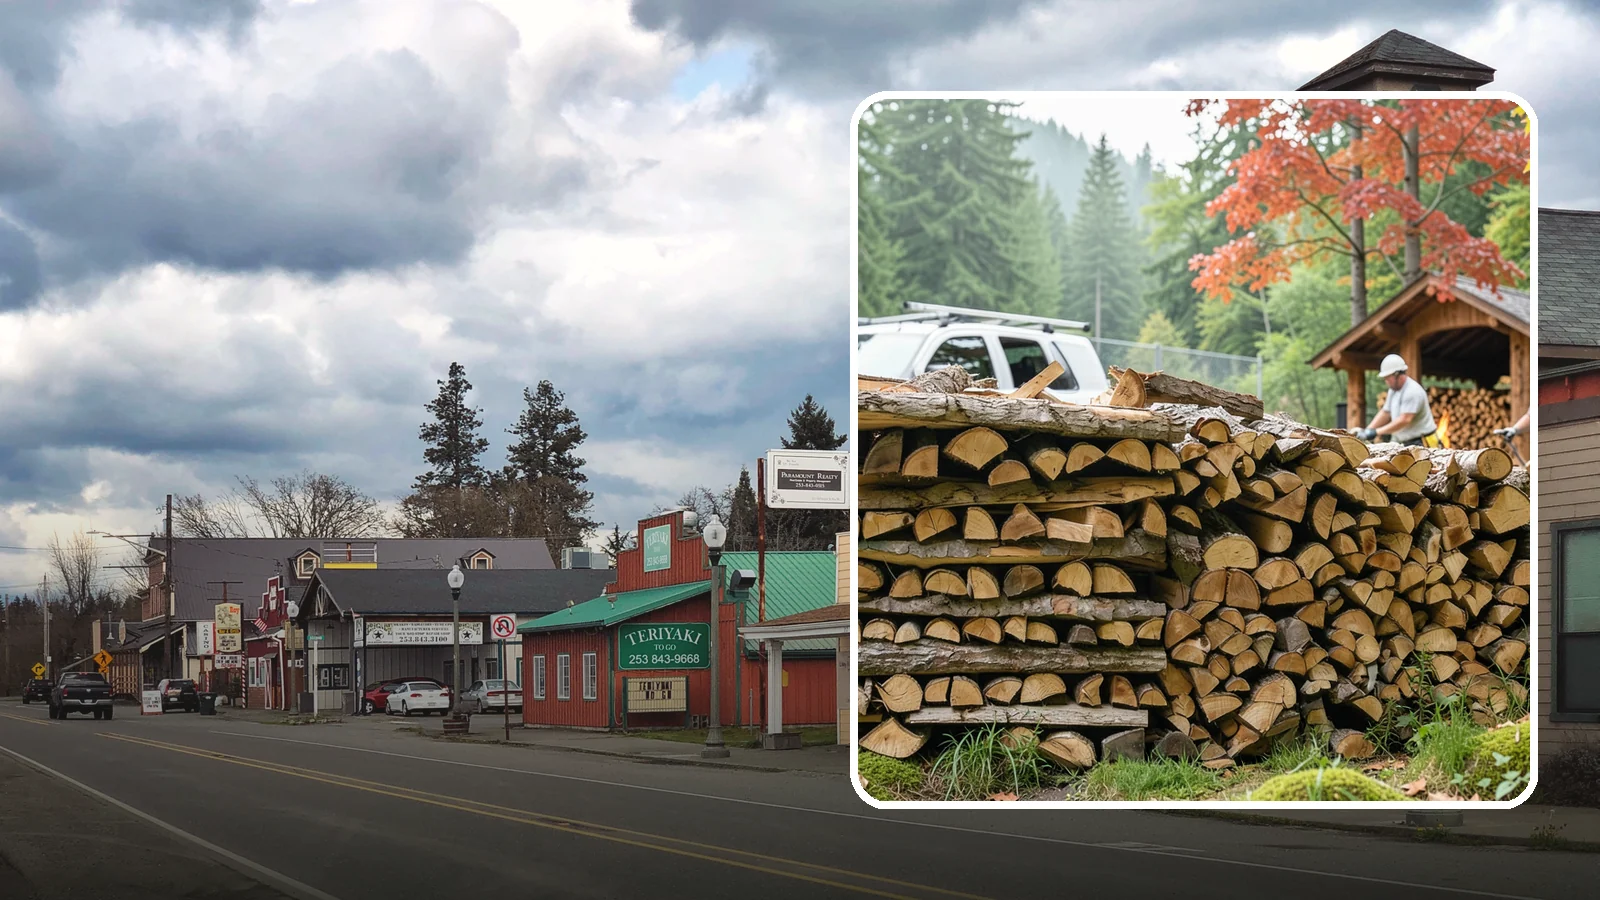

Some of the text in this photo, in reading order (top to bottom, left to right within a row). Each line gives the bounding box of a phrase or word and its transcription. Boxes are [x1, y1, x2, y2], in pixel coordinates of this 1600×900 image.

[781, 471, 839, 480] PARAMOUNT REALTY
[625, 627, 702, 646] TERIYAKI
[628, 653, 700, 664] 253 843-9668
[639, 681, 672, 691] TERIYAKI
